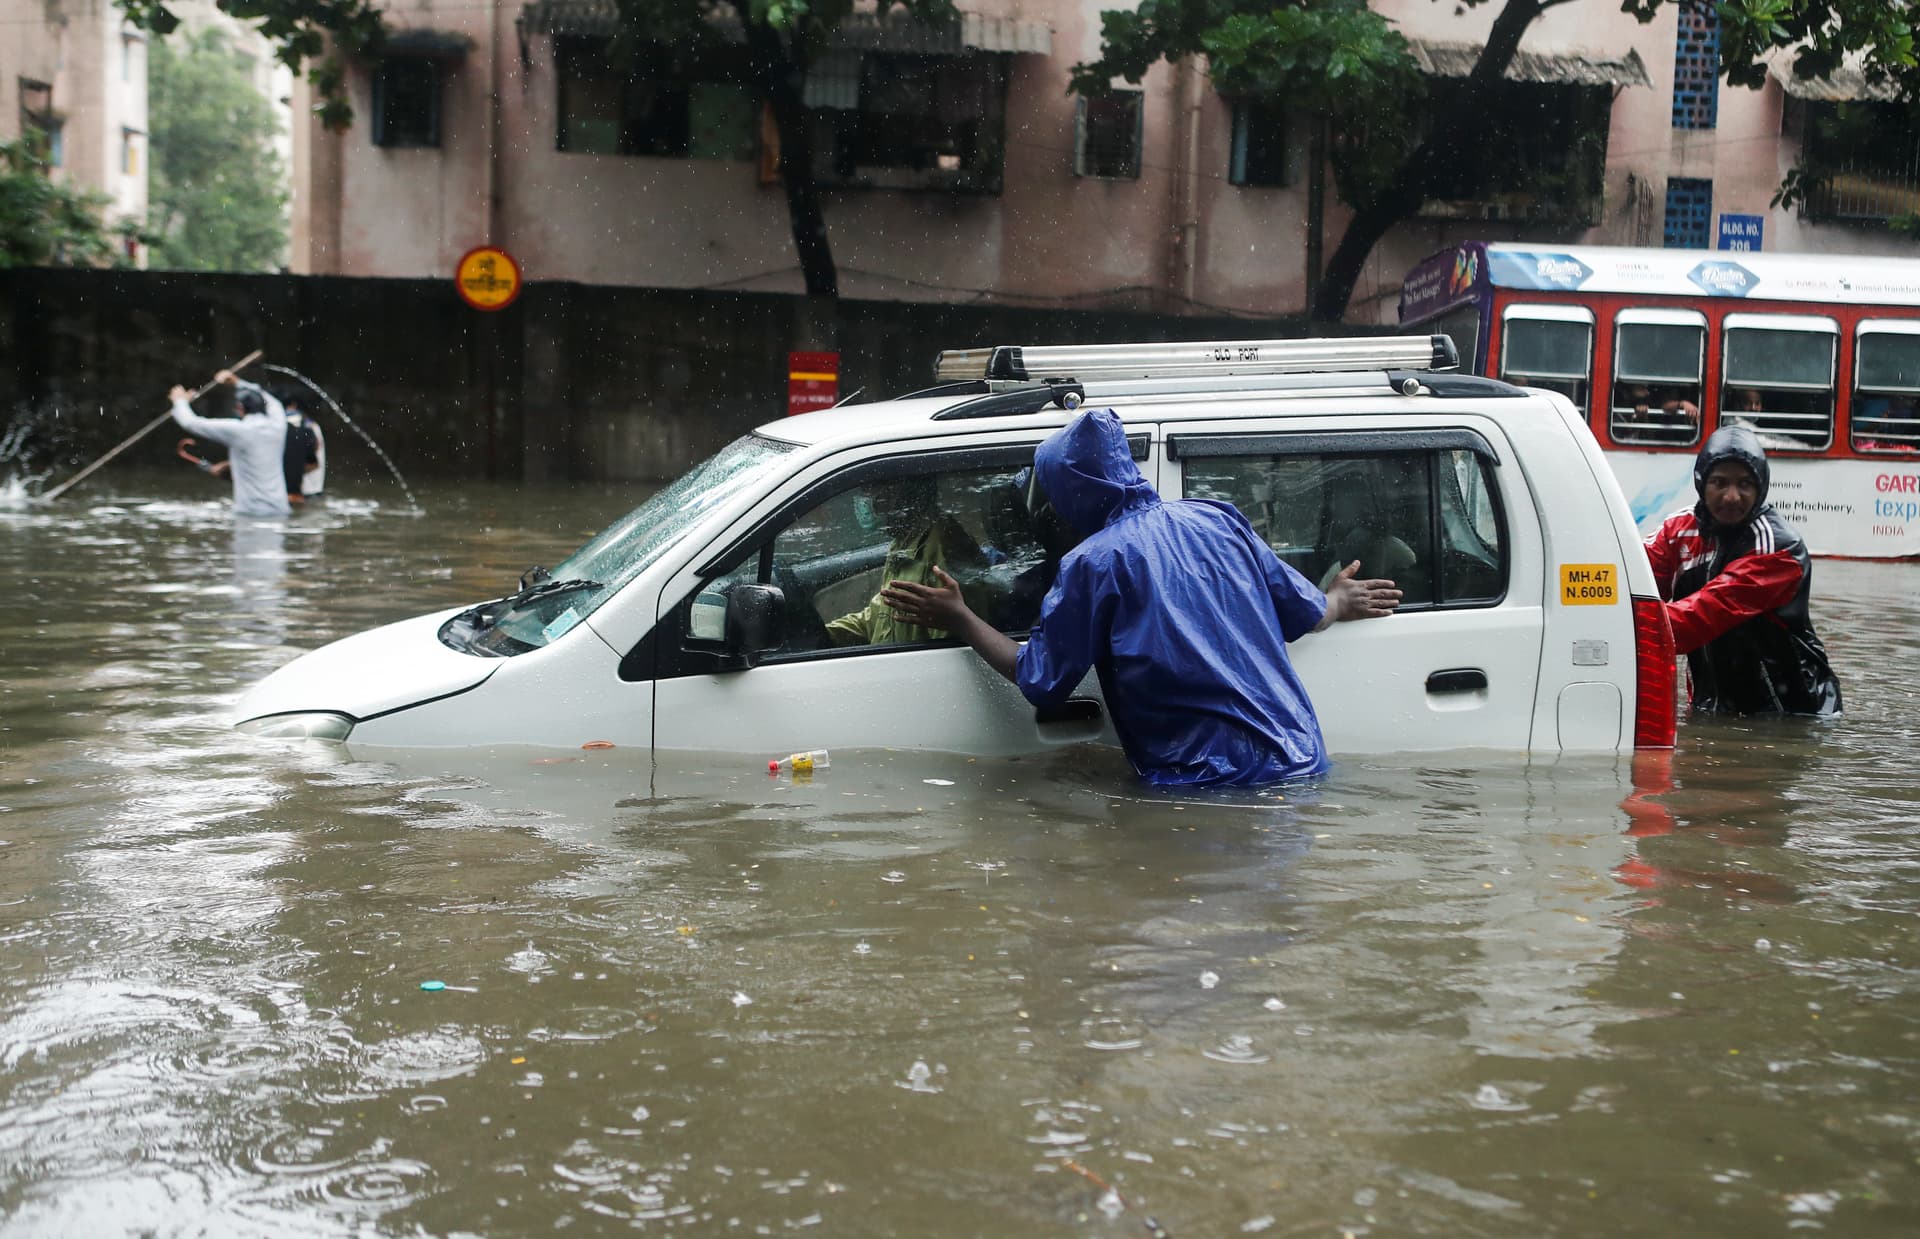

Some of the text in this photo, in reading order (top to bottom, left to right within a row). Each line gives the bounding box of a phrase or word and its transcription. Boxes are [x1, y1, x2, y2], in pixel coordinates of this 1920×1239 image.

[1722, 221, 1759, 236] BLDG. NO.
[1239, 347, 1258, 361] PORT
[1875, 474, 1920, 493] GAR
[1772, 500, 1855, 515] tile Machinery,
[1875, 498, 1920, 523] texp
[1872, 524, 1904, 536] INDIA
[1569, 570, 1609, 582] MH.47
[1566, 586, 1612, 598] N.6009
